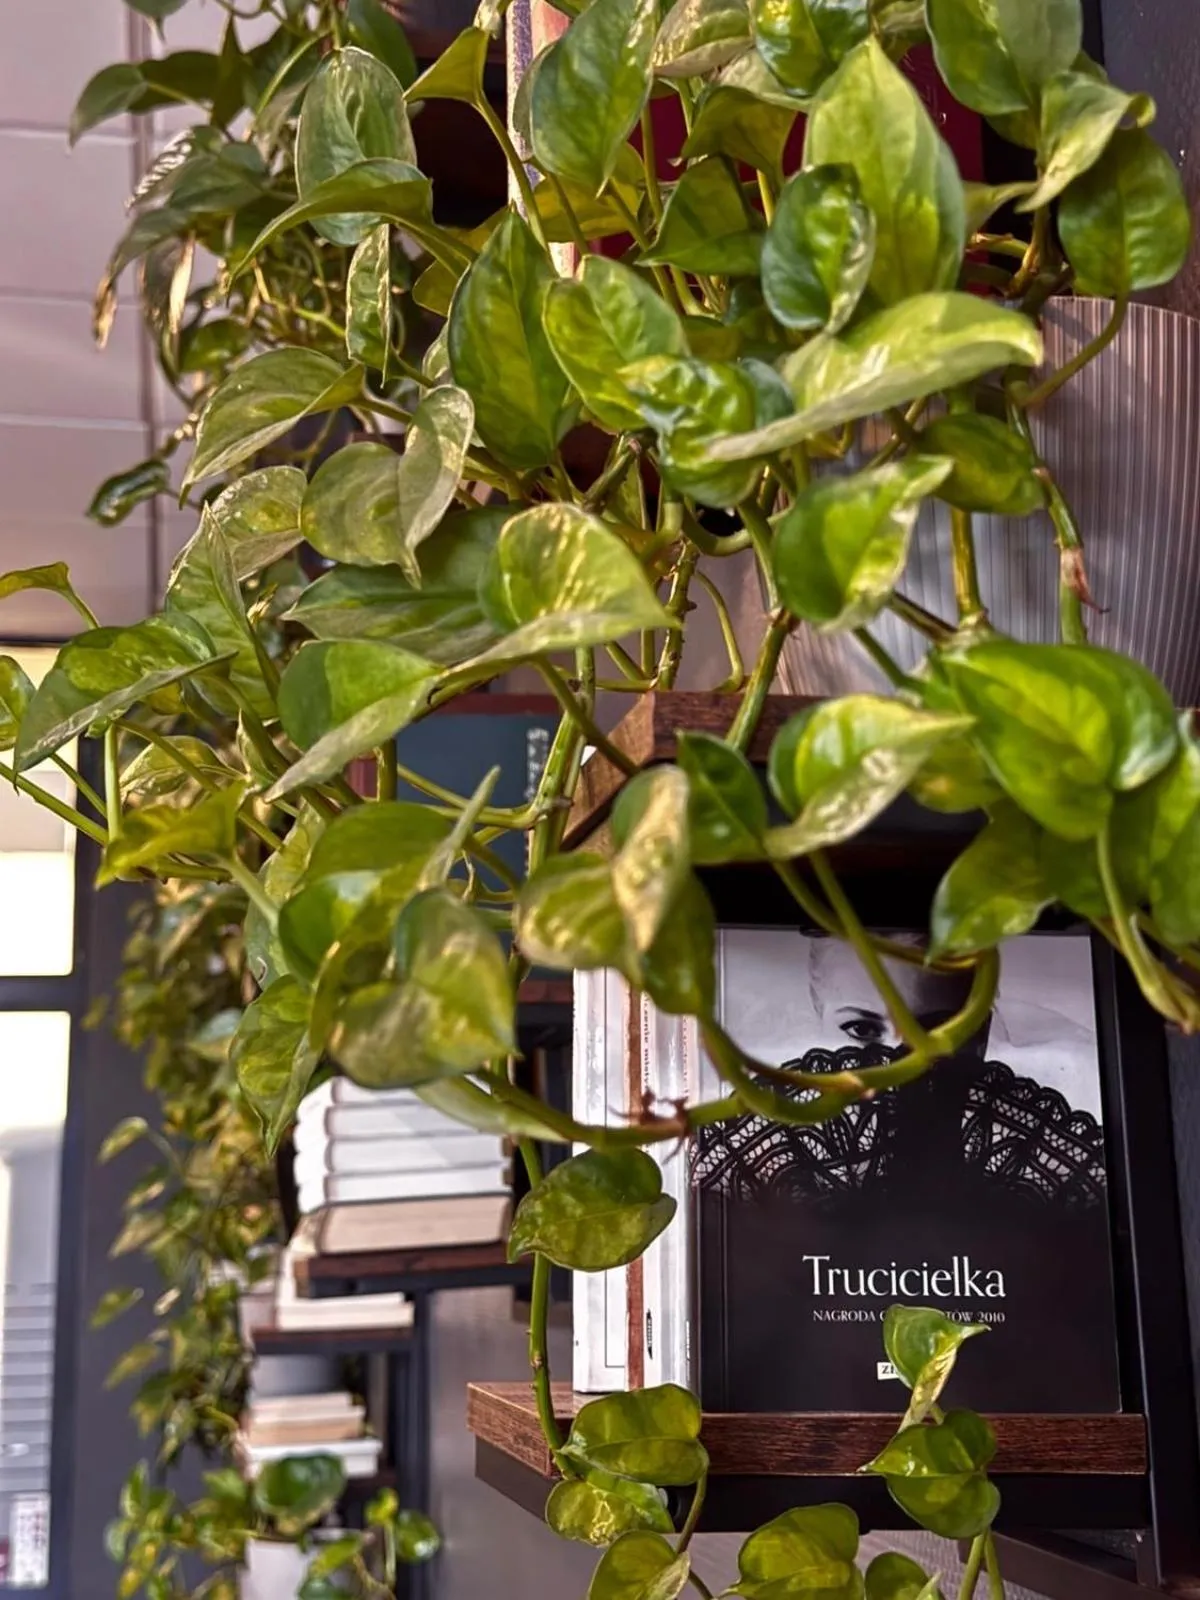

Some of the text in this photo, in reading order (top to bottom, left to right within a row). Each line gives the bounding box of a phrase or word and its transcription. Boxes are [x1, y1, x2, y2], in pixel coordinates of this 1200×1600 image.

[802, 1255, 1006, 1298] Trucicielka
[813, 1310, 876, 1321] NAGRODA
[977, 1311, 1005, 1323] 2010
